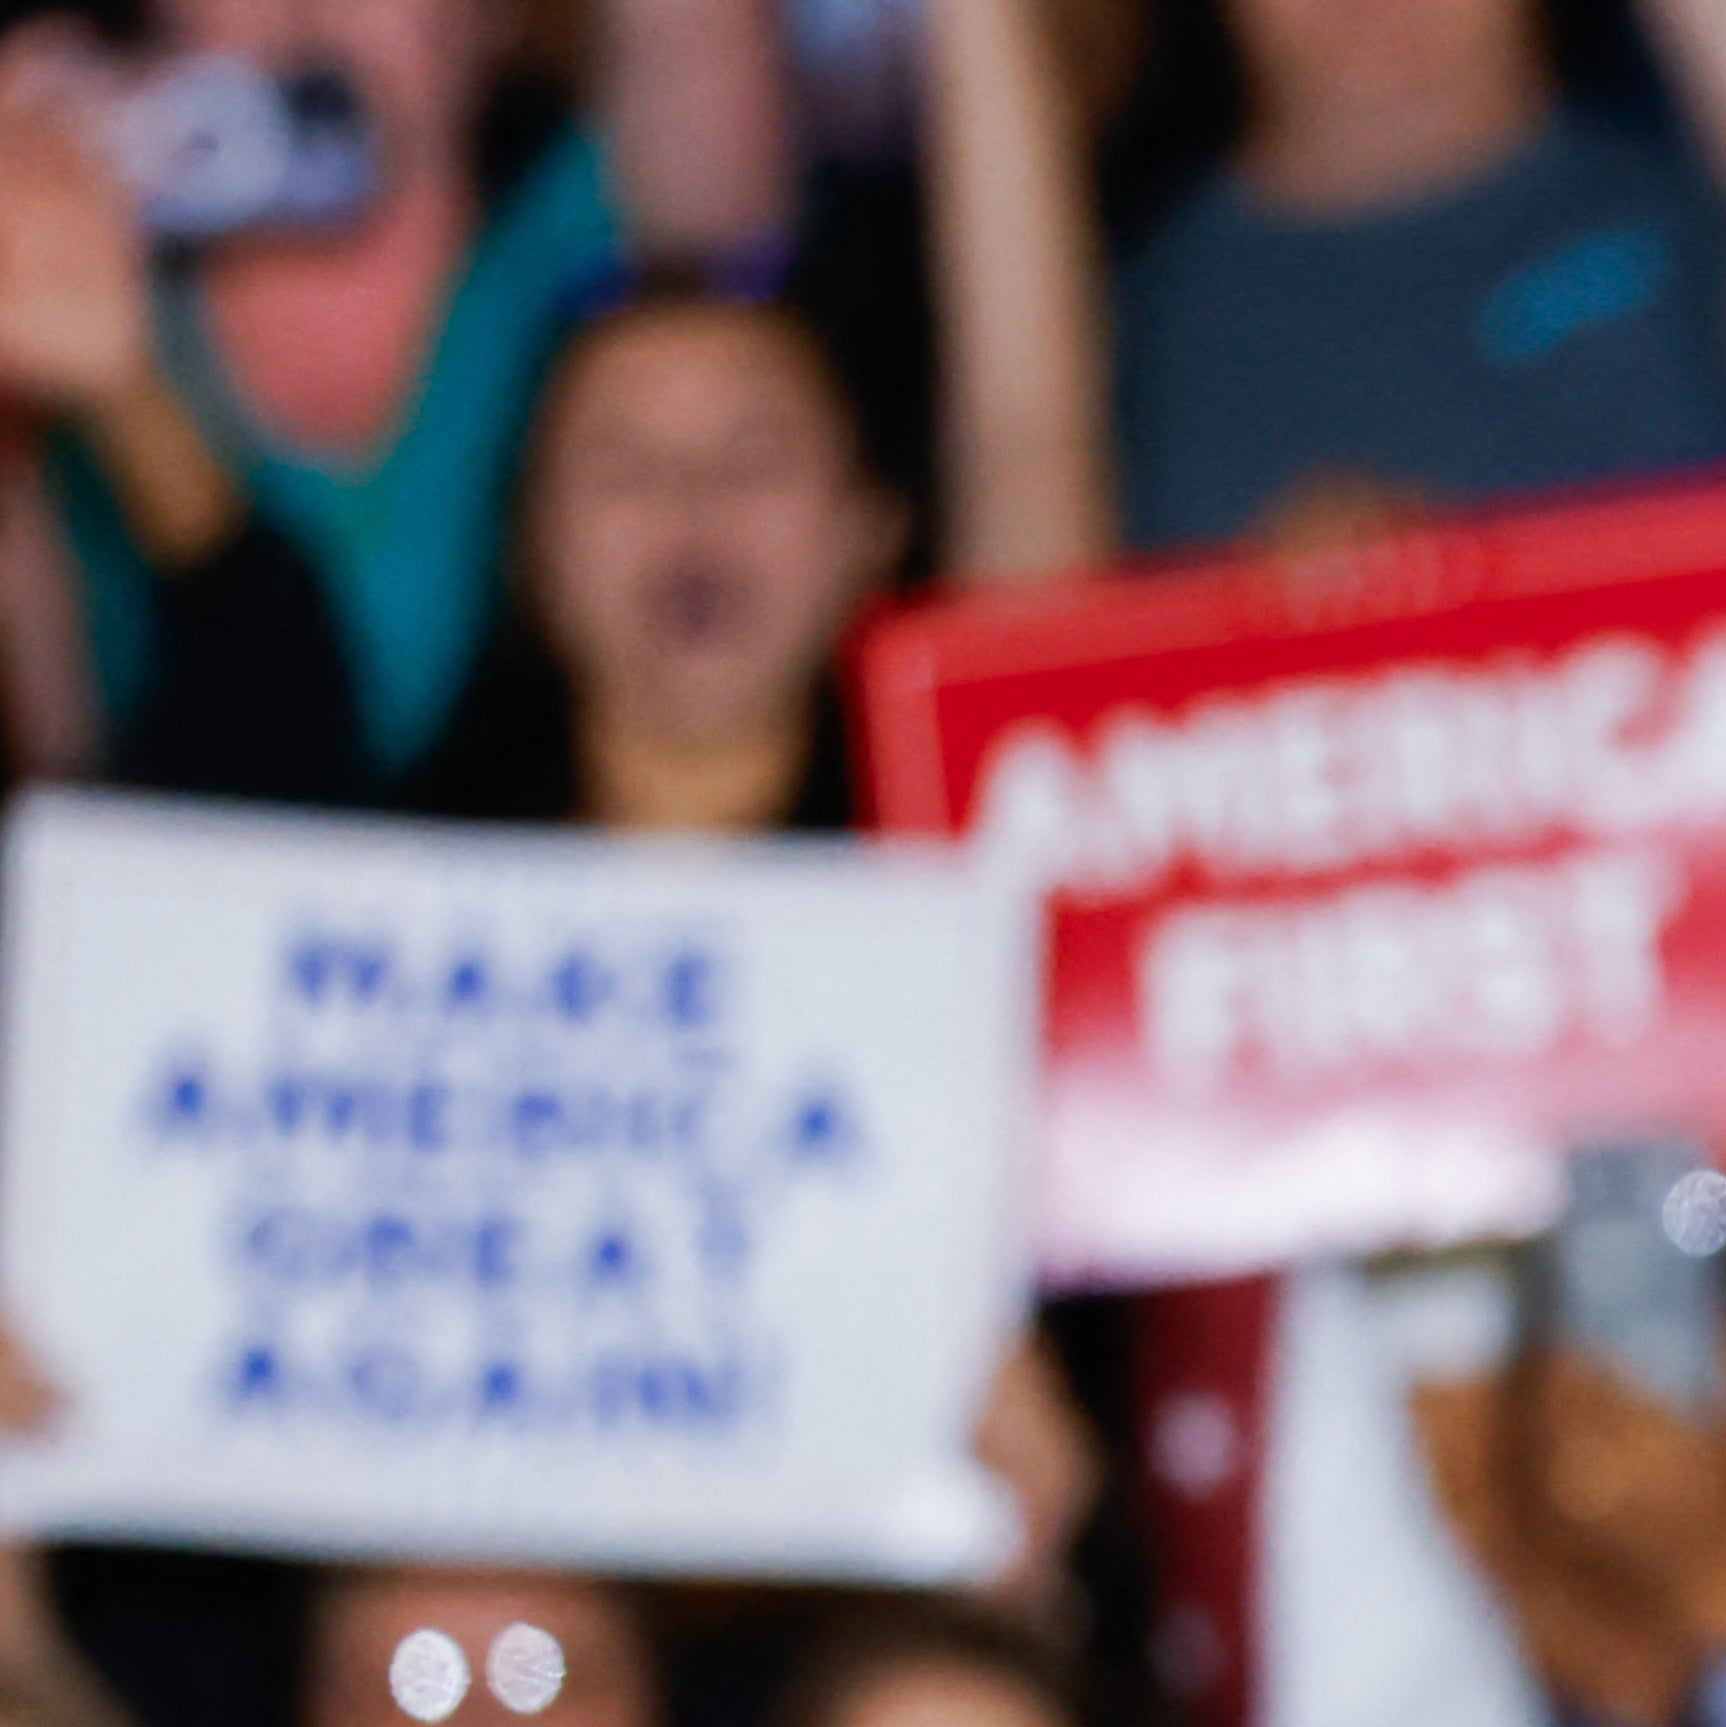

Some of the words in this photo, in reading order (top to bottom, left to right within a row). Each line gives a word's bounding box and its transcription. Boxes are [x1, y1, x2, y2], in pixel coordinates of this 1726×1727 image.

[282, 930, 734, 1030] MAKE
[1140, 842, 1682, 1078] FIRST
[136, 1046, 874, 1174] AMERICA
[230, 1192, 752, 1298] GREAT
[218, 1326, 778, 1442] AGAIN!
